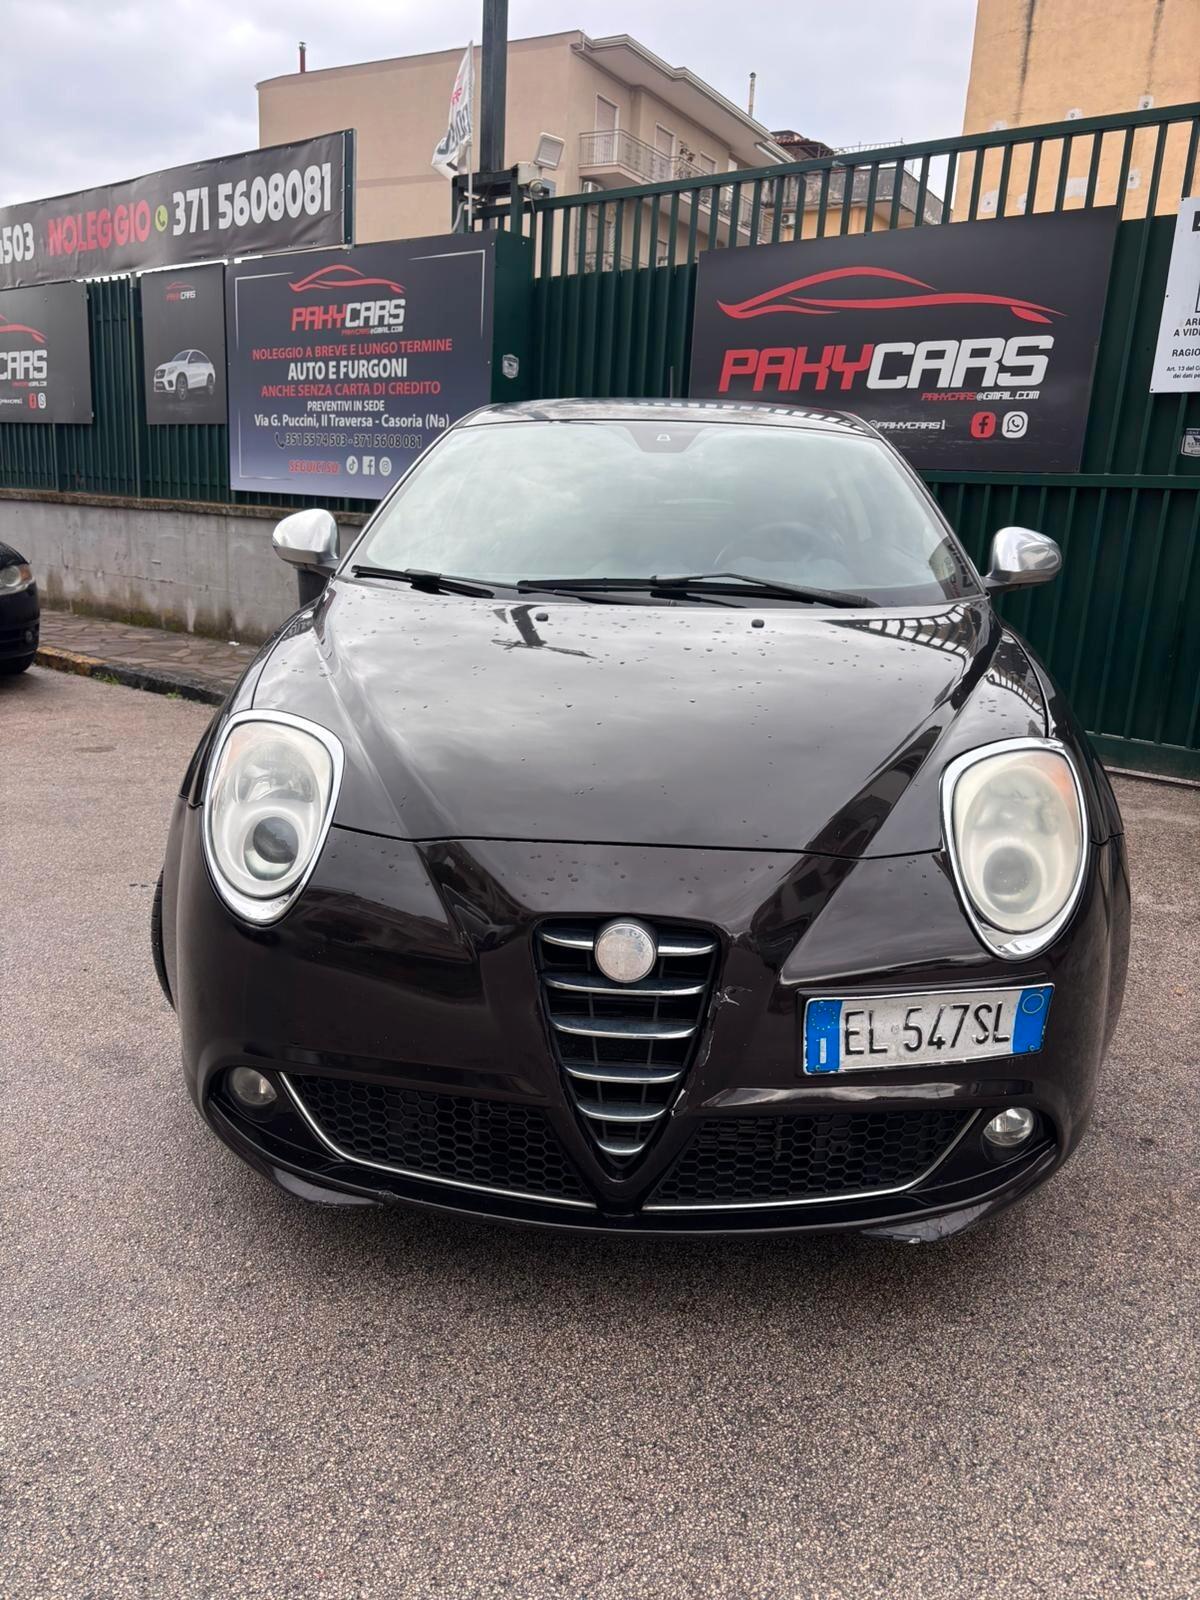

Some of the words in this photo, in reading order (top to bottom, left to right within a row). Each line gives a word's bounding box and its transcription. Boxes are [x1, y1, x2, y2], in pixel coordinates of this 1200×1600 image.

[48, 200, 151, 256] NOLEGGIO
[173, 187, 209, 236] 371
[218, 162, 331, 229] 5608081
[291, 299, 405, 331] PAKYCARS
[1174, 329, 1180, 337] A
[252, 347, 303, 360] NOLEGGIO
[306, 346, 312, 358] A
[315, 345, 347, 357] BREVE
[350, 344, 356, 355] E
[359, 341, 397, 355] LUNGO
[400, 339, 452, 353] TERMINE
[287, 362, 325, 381] AUTO
[329, 361, 336, 379] E
[340, 358, 407, 379] FURGONI
[717, 335, 1055, 393] PAKYCARS
[261, 385, 296, 397] ANCHE
[298, 384, 332, 397] SENZA
[335, 383, 370, 396] CARTA
[374, 383, 386, 396] DI
[388, 381, 441, 395] CREDITO
[307, 400, 352, 412] PREVENTIVI
[354, 400, 362, 412] IN
[363, 400, 385, 411] SEDE
[254, 414, 269, 426] Via
[271, 414, 280, 426] G.
[282, 413, 319, 429] Puccini,
[329, 414, 373, 427] Traversa
[381, 413, 422, 427] Casoria
[425, 413, 449, 430] (Na)
[845, 1010, 888, 1055] EL
[903, 1002, 1010, 1052] 547SL
